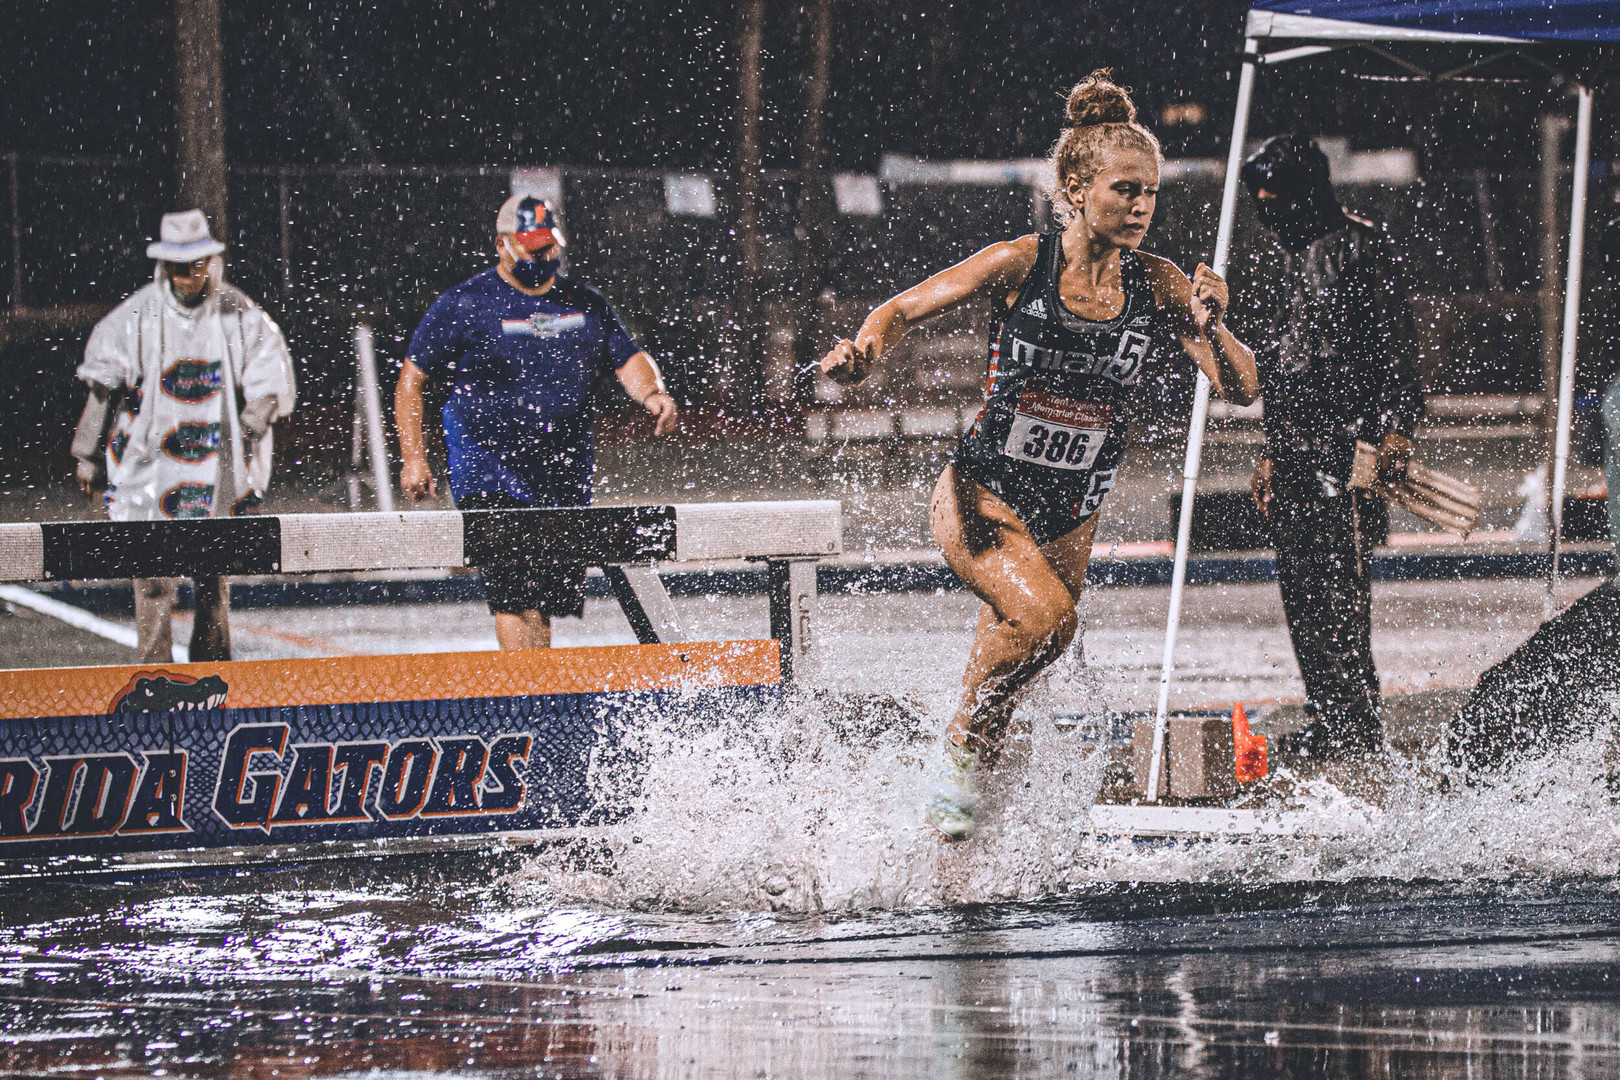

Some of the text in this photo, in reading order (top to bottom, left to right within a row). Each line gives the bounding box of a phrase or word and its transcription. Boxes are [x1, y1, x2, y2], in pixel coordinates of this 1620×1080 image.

[1020, 306, 1048, 320] adidas
[1129, 315, 1152, 327] ACC
[1011, 336, 1113, 376] mia
[1105, 332, 1149, 382] 5
[1030, 402, 1106, 424] Memorial Classic
[1023, 424, 1091, 466] 386
